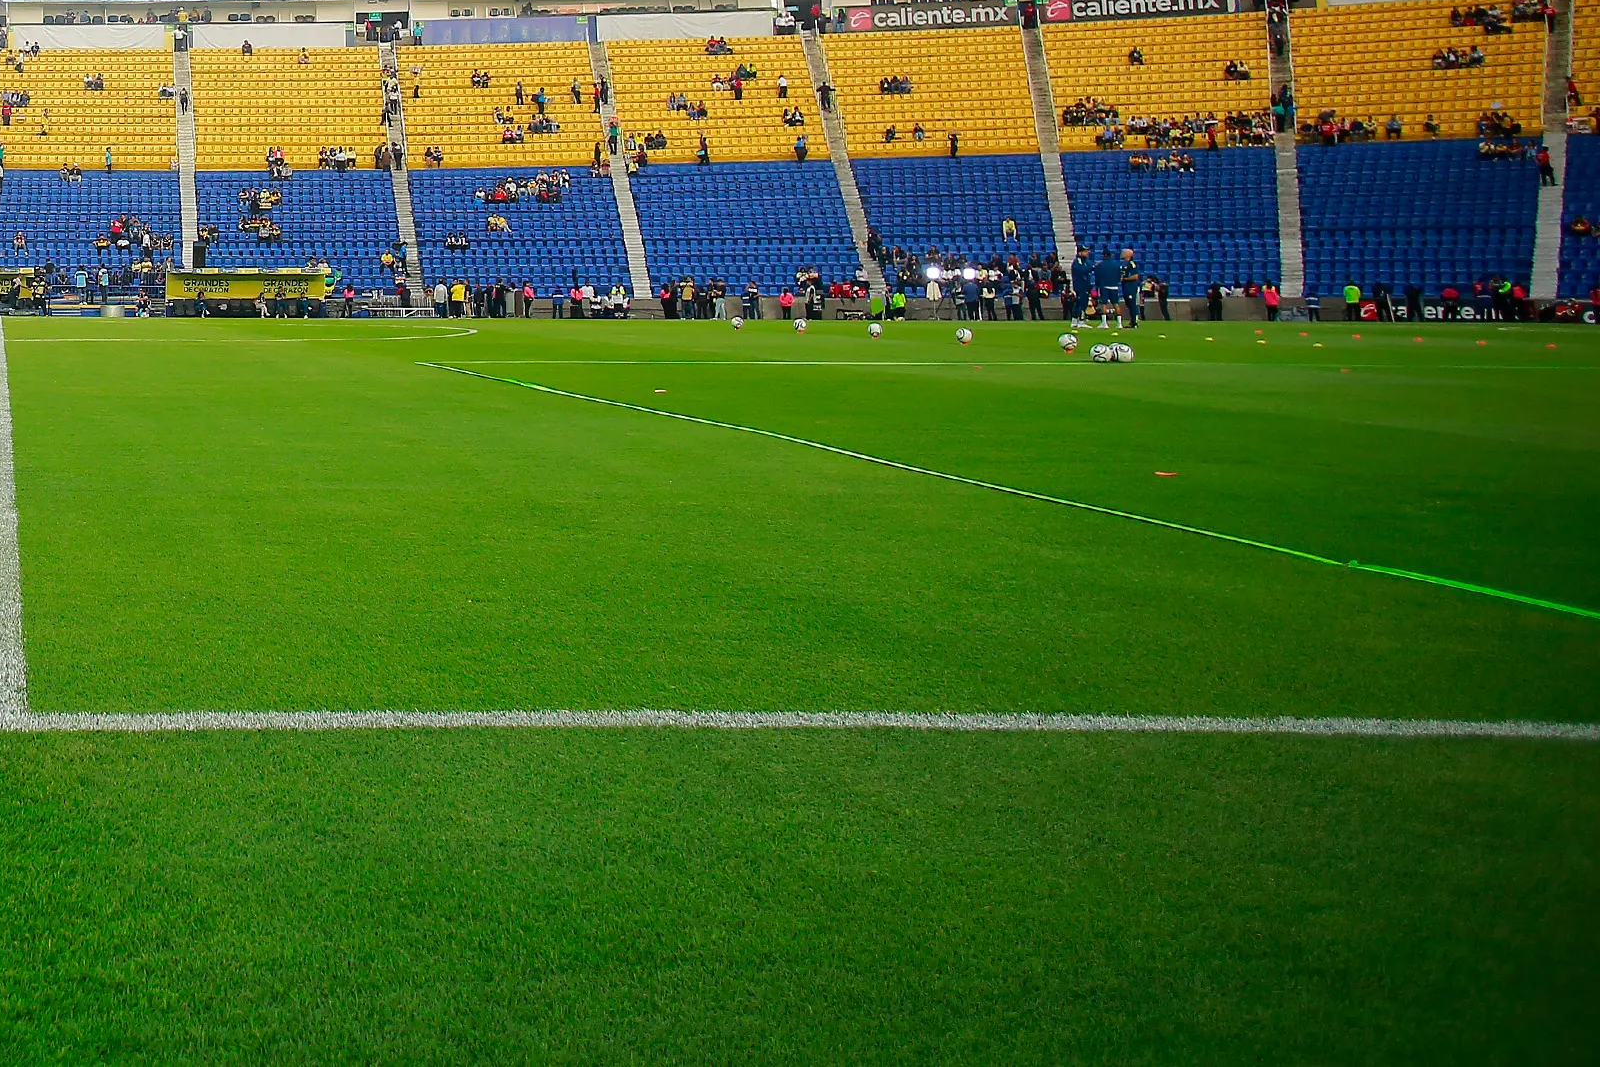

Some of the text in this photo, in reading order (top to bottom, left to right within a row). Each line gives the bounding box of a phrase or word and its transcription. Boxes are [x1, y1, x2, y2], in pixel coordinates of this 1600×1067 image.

[873, 5, 1009, 28] caliente.mx
[184, 278, 230, 287] GRANDES
[263, 279, 309, 287] GRANDES
